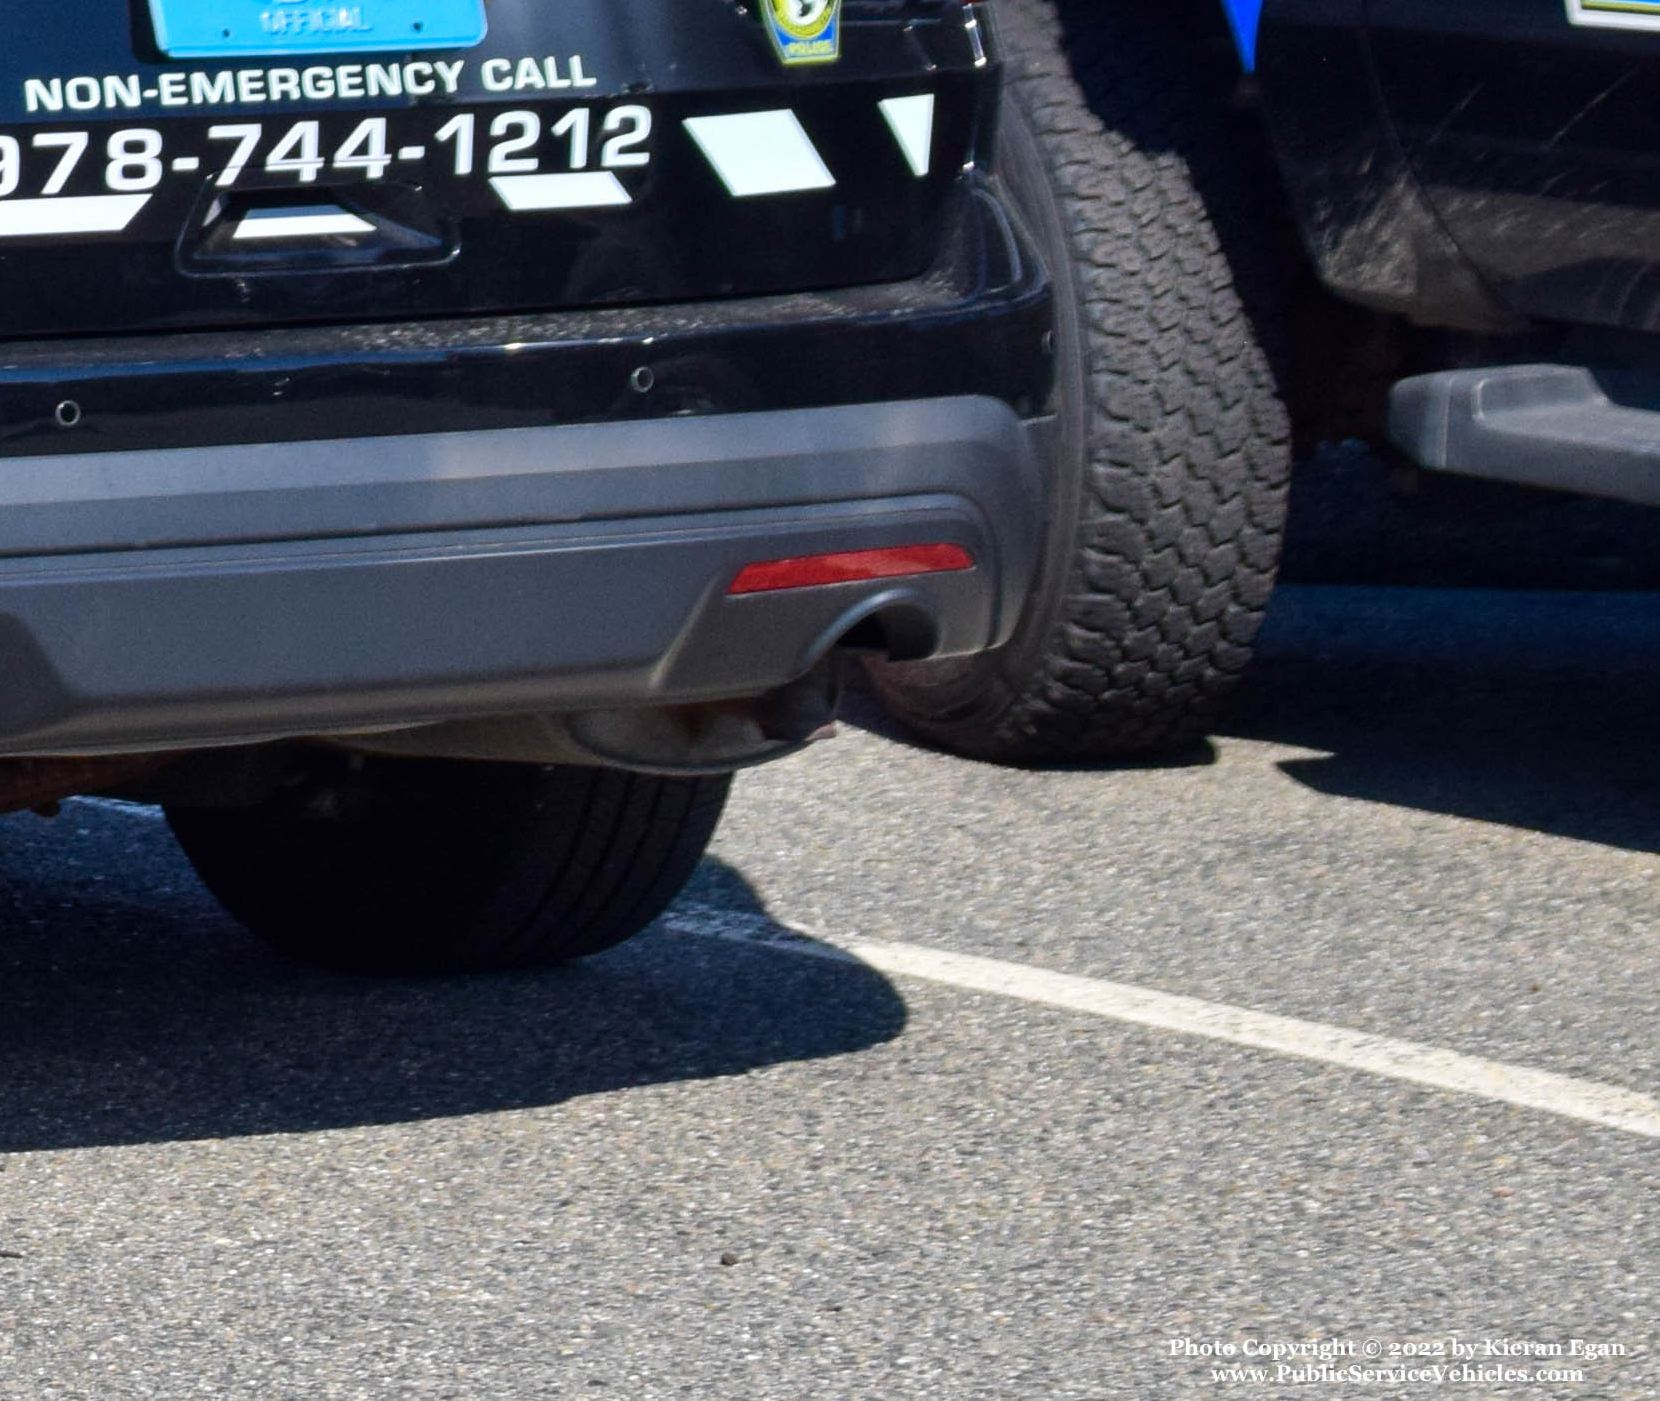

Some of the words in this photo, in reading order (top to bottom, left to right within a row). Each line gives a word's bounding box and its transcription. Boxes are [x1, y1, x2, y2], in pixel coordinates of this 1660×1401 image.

[259, 7, 373, 35] OFFICIAL
[24, 61, 463, 114] NON-EMERGENCY
[480, 56, 597, 90] CALL
